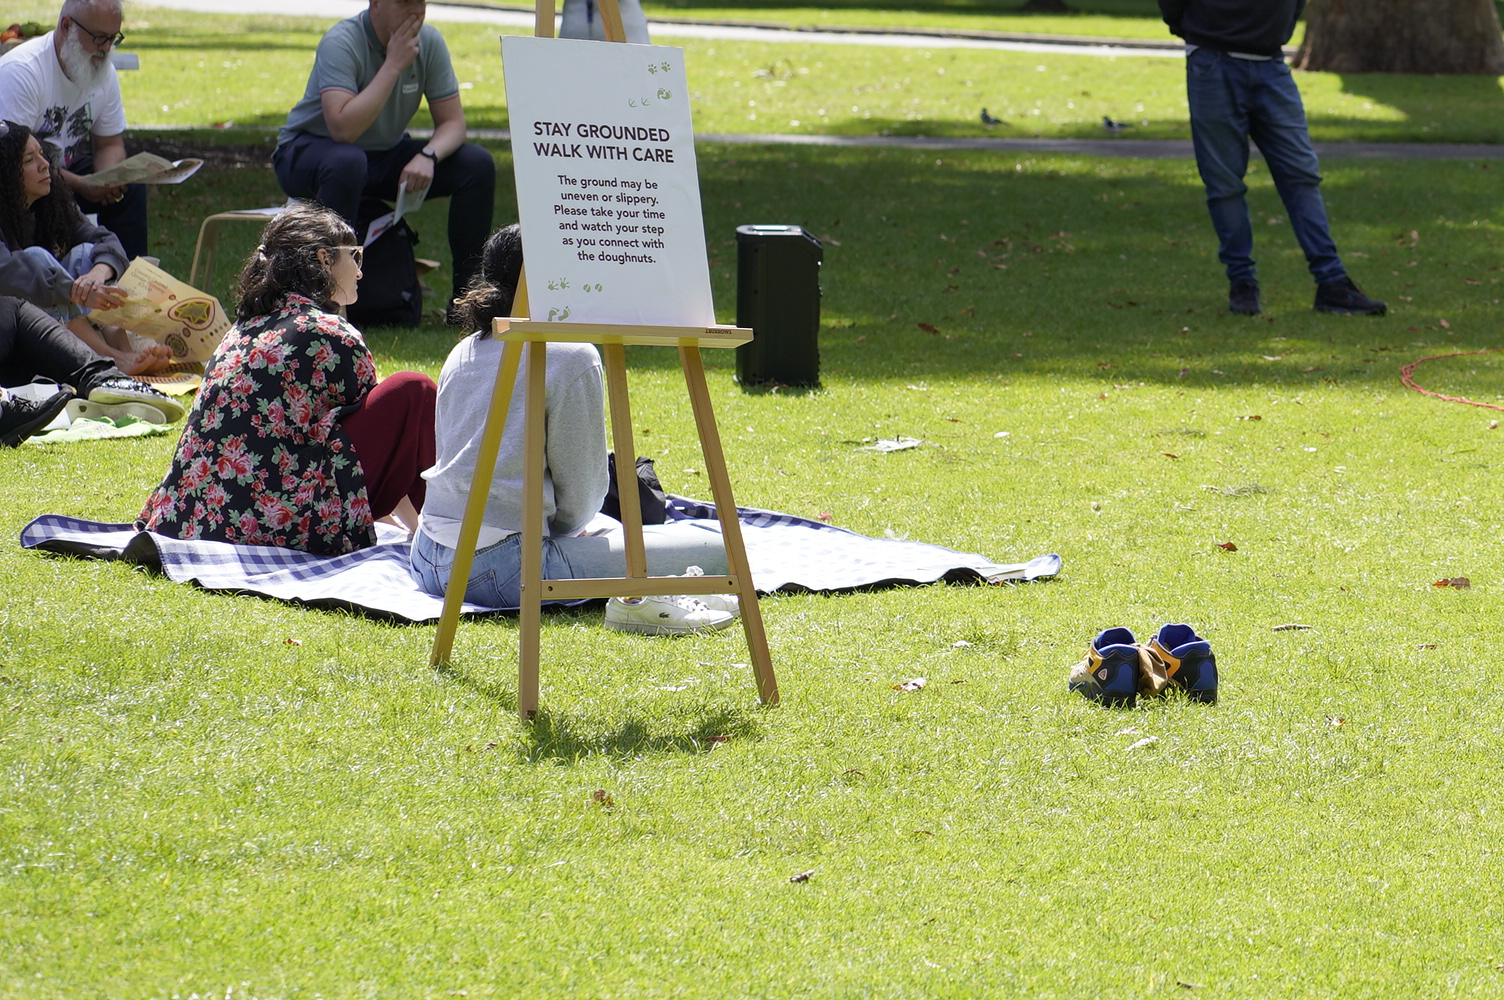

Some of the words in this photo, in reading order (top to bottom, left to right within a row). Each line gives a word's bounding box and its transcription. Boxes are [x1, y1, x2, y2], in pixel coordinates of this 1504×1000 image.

[534, 121, 572, 137] STAY
[577, 123, 670, 142] GROUNDED
[533, 142, 583, 158] WALK
[586, 145, 628, 161] WITH
[632, 147, 674, 163] CARE
[557, 175, 577, 186] The
[580, 177, 617, 189] ground
[620, 180, 642, 192] may
[644, 179, 658, 190] be
[561, 193, 599, 201] uneven
[601, 194, 613, 202] or
[616, 192, 659, 207] slippery.
[554, 204, 588, 216] Please
[590, 206, 613, 217] take
[616, 210, 640, 220] your
[642, 209, 665, 219] time
[559, 220, 578, 230] and
[581, 221, 613, 232] watch
[615, 225, 639, 235] your
[641, 225, 664, 237] step
[562, 237, 574, 245] as
[576, 238, 596, 248] you
[599, 239, 639, 248] connect
[641, 238, 664, 249] with
[577, 250, 595, 261] the
[598, 251, 656, 265] doughnuts.
